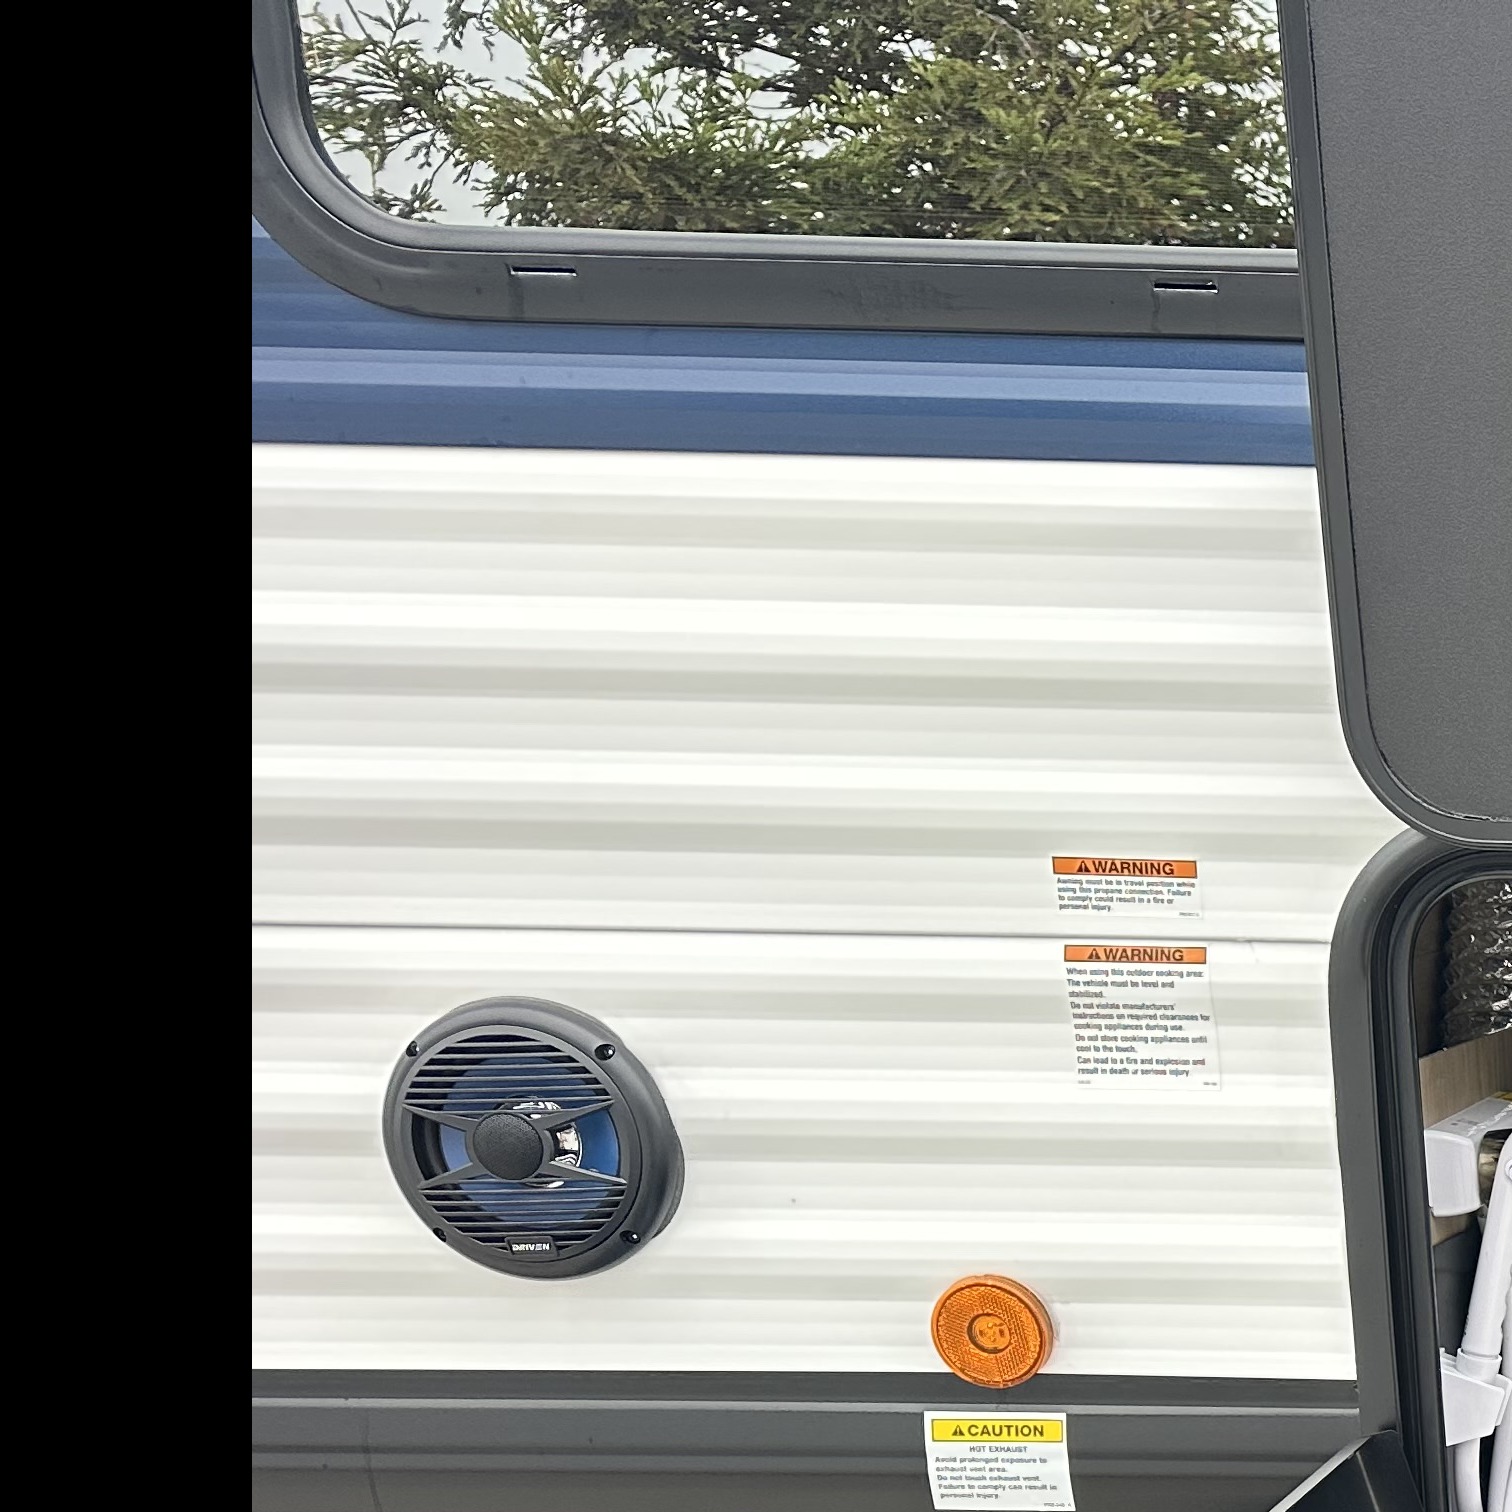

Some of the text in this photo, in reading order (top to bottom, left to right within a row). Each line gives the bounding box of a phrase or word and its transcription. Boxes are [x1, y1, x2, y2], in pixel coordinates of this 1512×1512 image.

[1092, 861, 1175, 875] WARNING
[1103, 948, 1184, 961] WARNING
[512, 1243, 550, 1251] DRIVEN
[968, 1425, 1044, 1437] CAUTION
